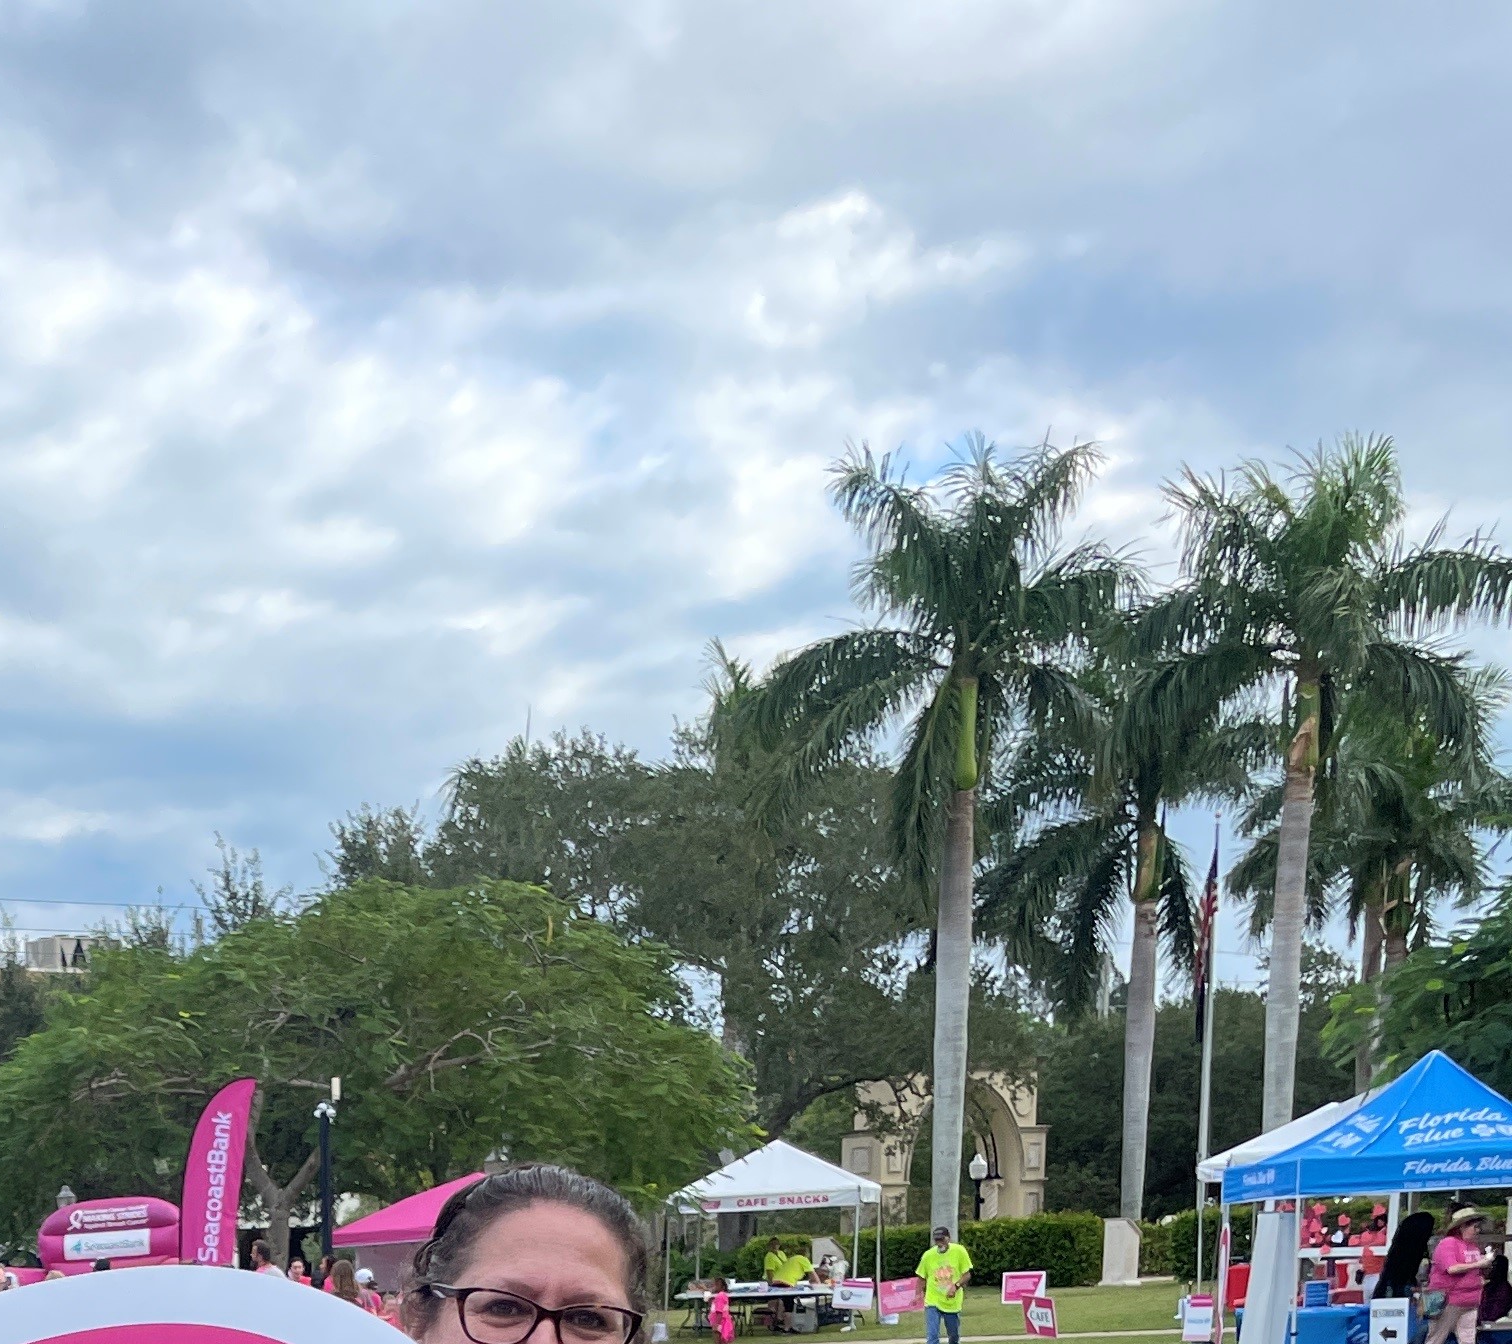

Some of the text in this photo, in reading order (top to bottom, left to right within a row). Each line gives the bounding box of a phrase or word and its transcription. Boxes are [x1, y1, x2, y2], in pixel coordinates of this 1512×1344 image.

[1398, 1107, 1507, 1135] Florida
[1403, 1127, 1465, 1147] Blue
[1403, 1156, 1473, 1175] Florida
[197, 1110, 233, 1264] SeacoastBank
[736, 1198, 768, 1208] CAFE
[778, 1194, 830, 1206] SNACKS
[1029, 1310, 1050, 1323] CAFE
